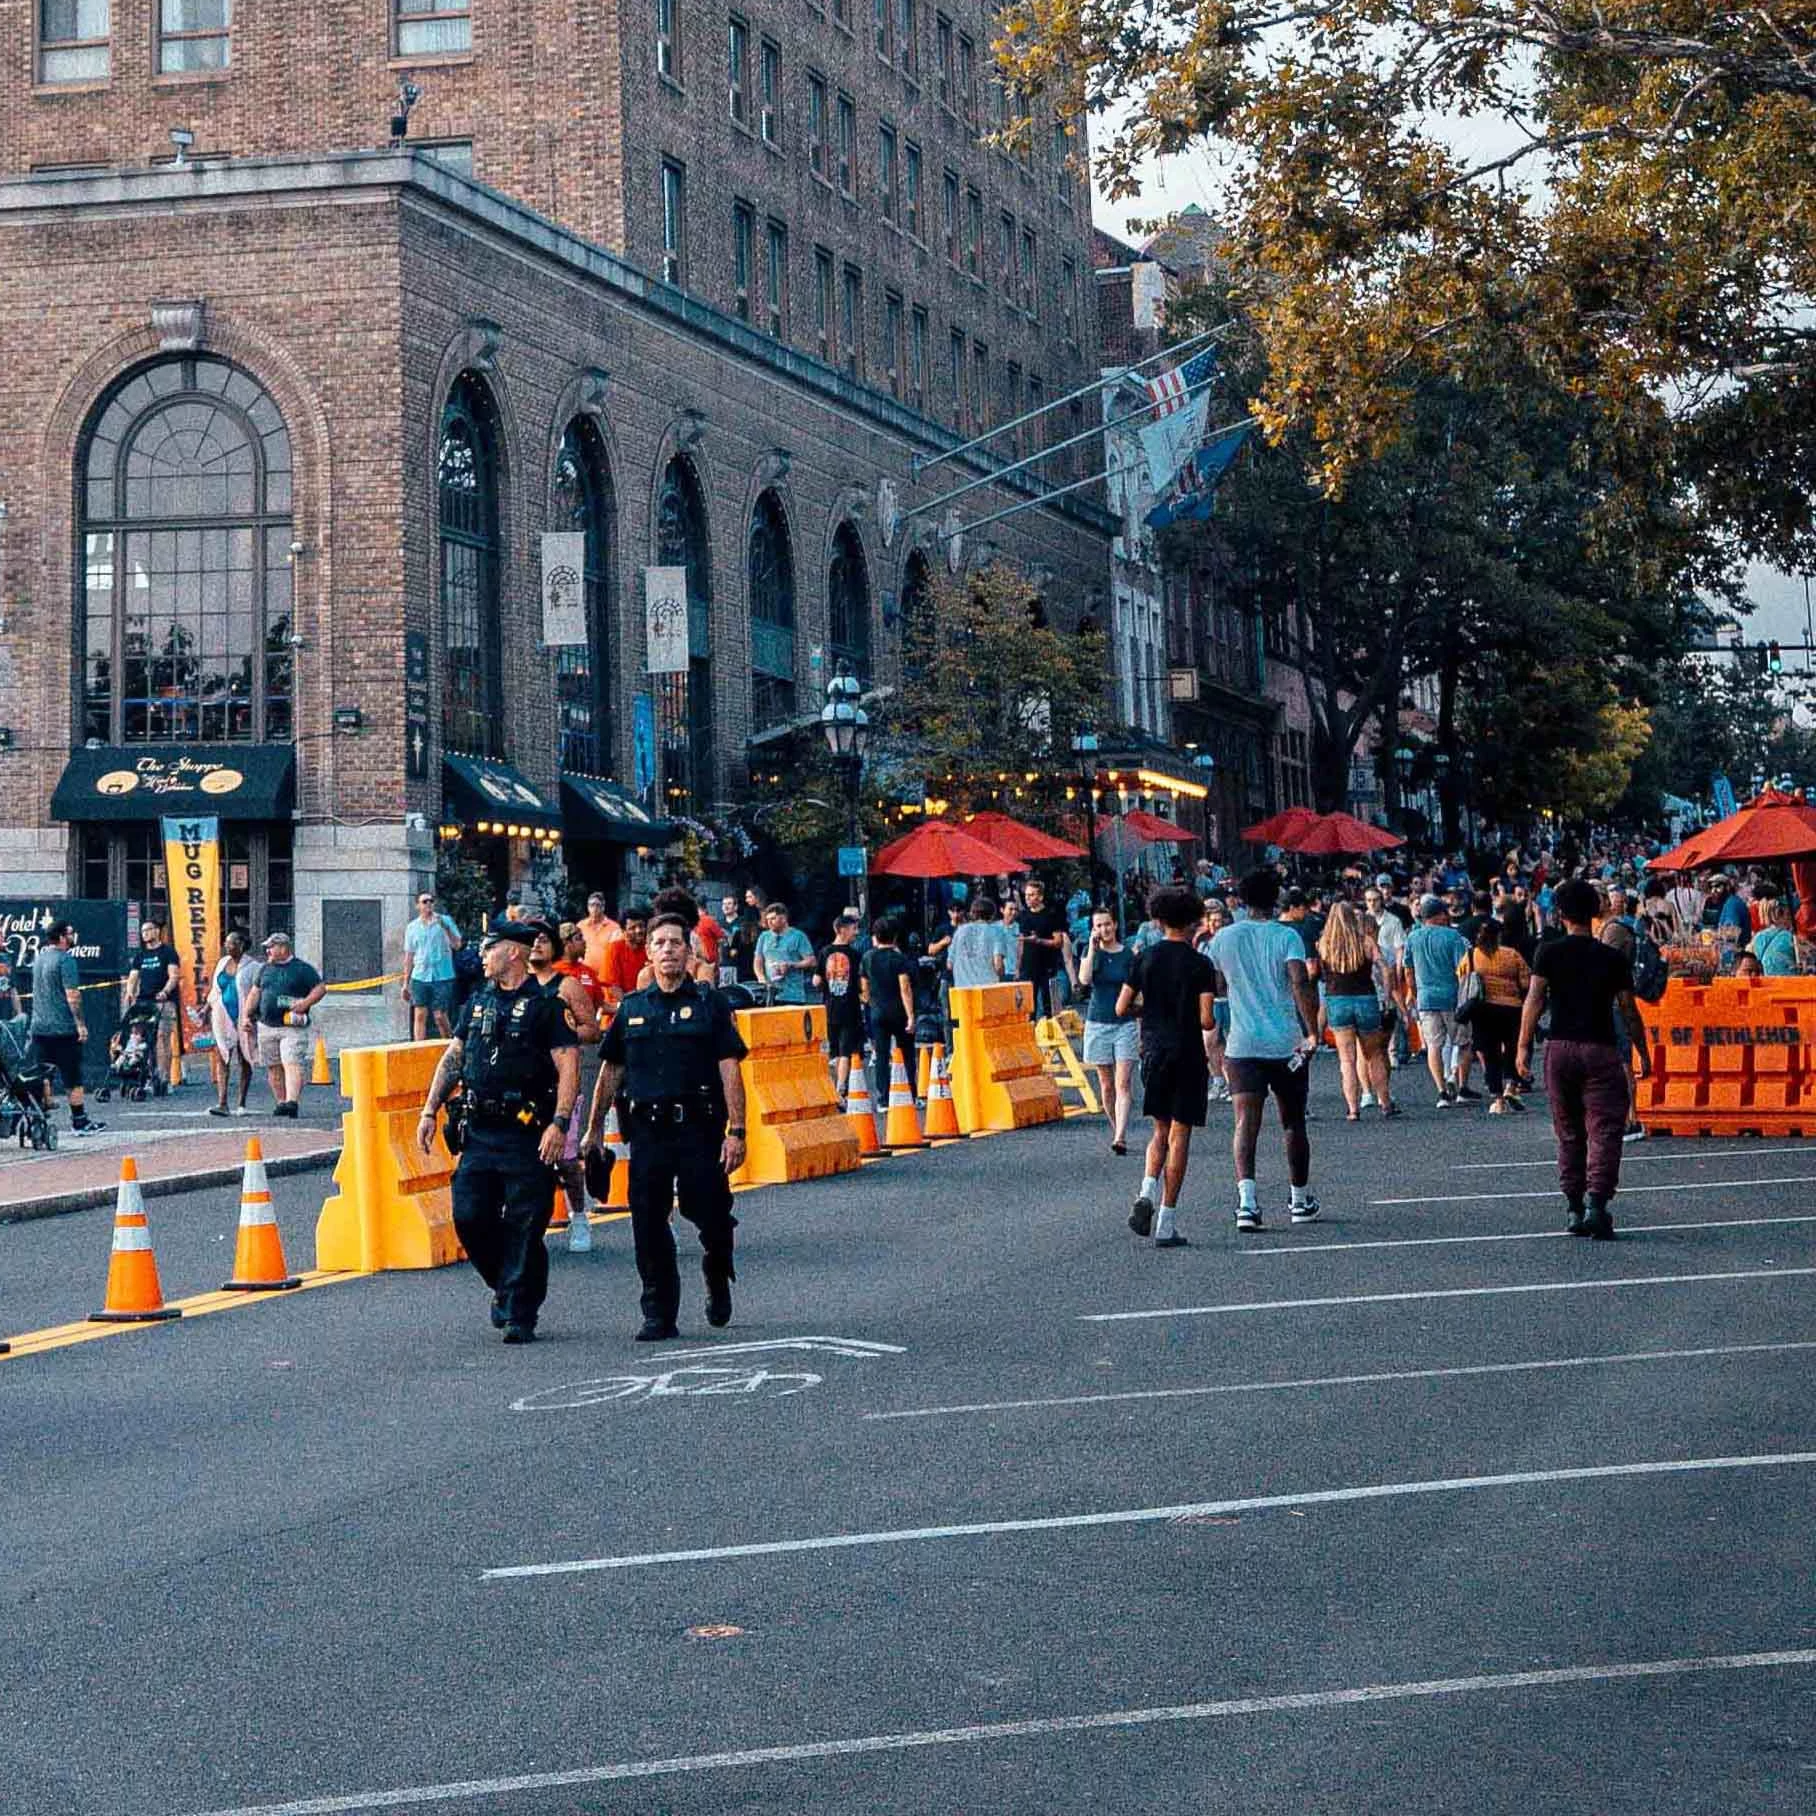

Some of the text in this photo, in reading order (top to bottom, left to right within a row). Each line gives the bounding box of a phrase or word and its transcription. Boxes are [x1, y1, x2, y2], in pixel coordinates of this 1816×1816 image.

[136, 757, 165, 771] The
[180, 824, 202, 879] MUG
[188, 887, 206, 1004] REFILL
[1672, 1027, 1693, 1045] OF
